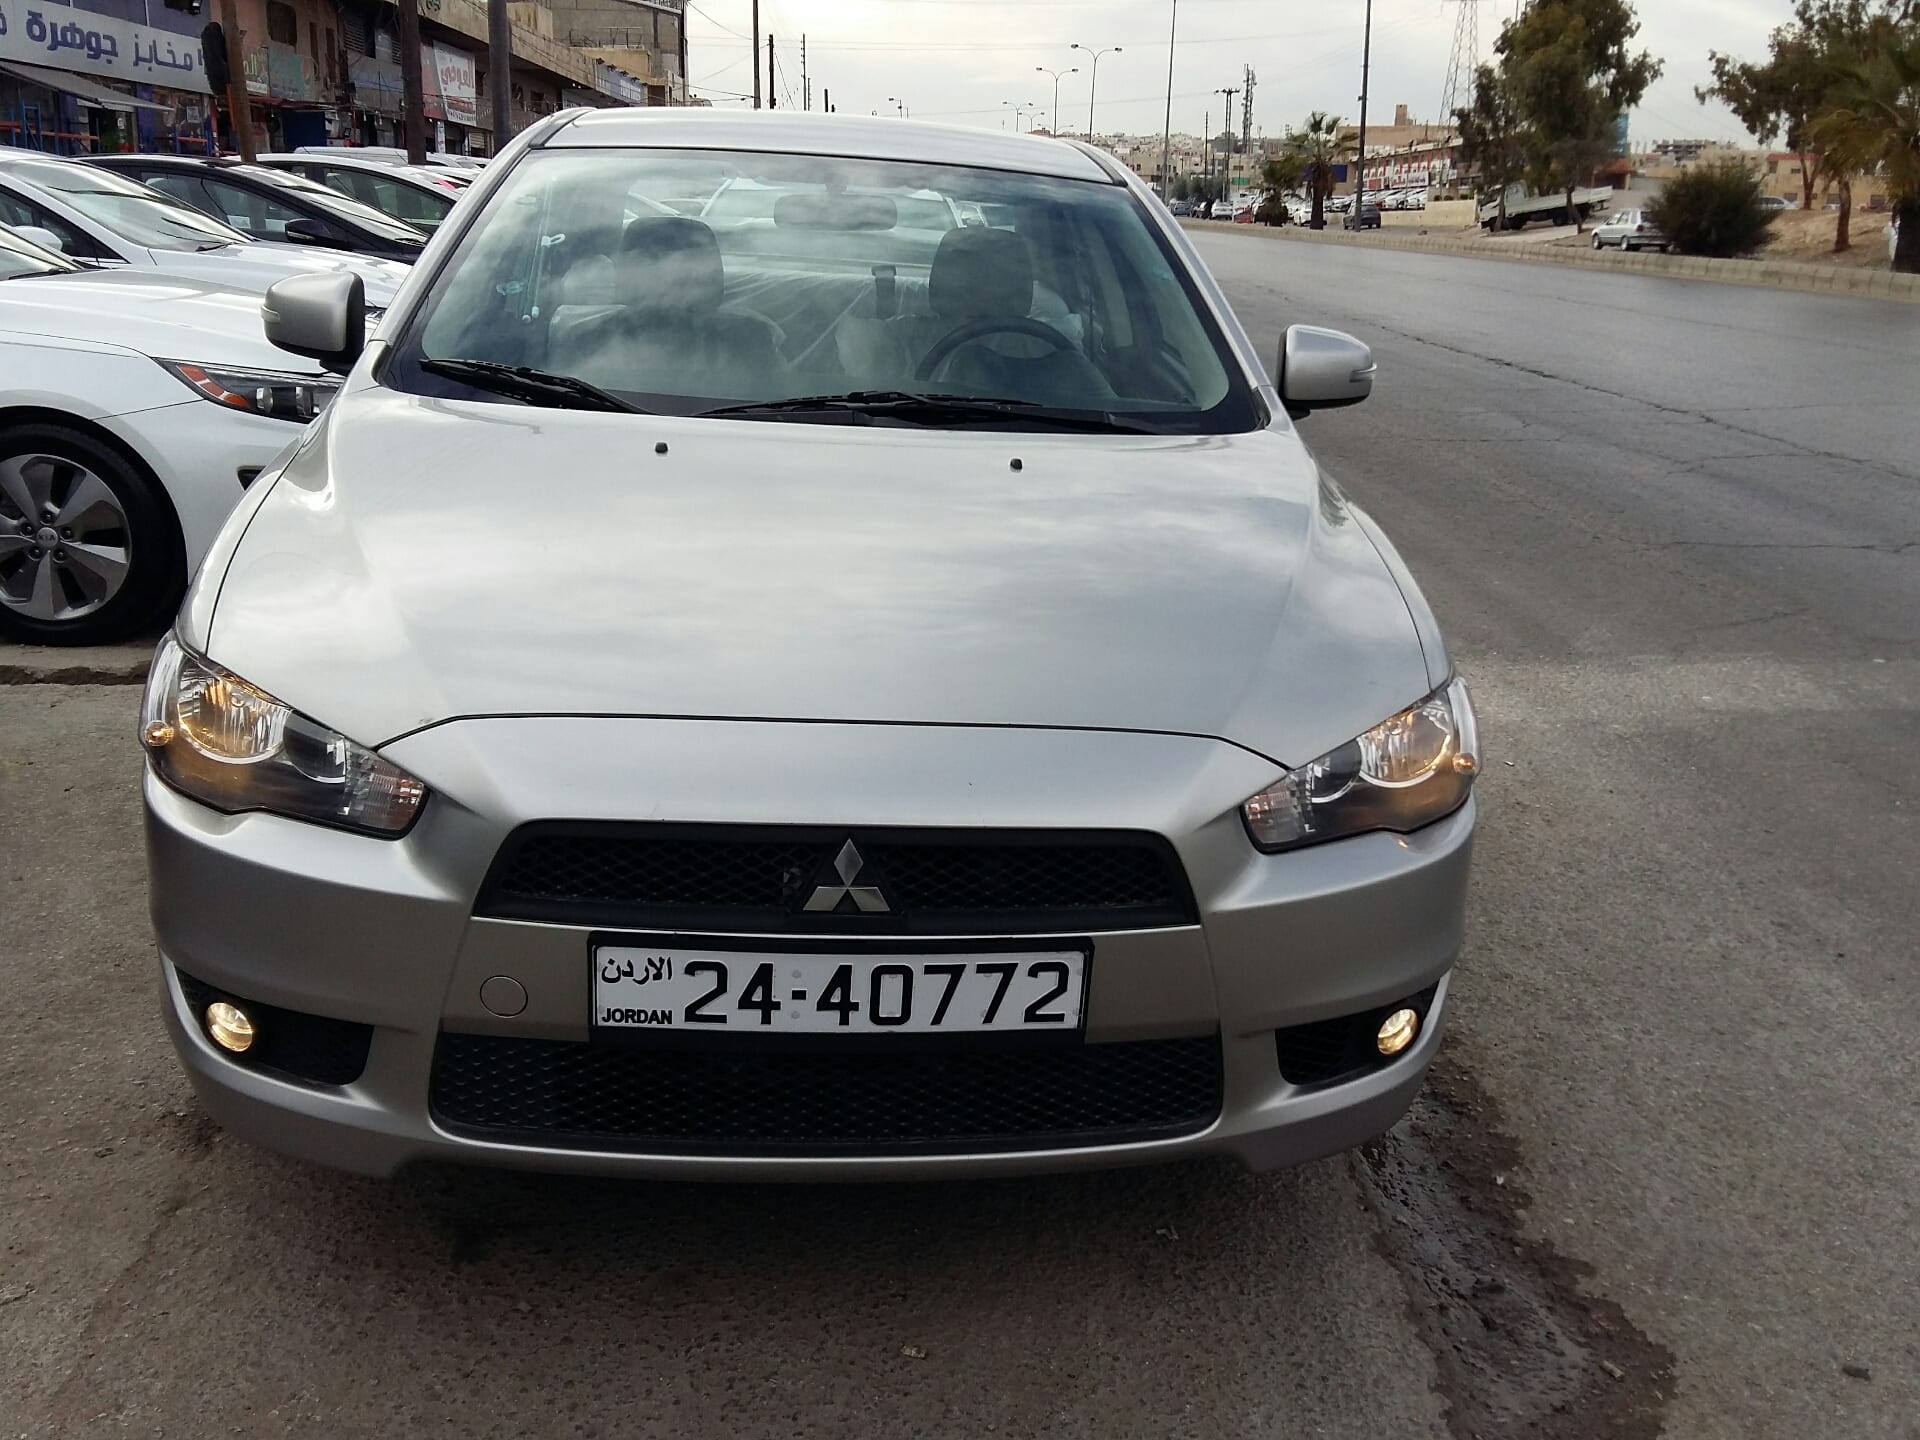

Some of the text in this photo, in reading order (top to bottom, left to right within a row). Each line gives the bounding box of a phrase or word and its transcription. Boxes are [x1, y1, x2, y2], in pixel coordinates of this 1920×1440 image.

[26, 10, 119, 64] جوهرة
[133, 34, 193, 71] مخابز
[602, 956, 673, 985] الاردن
[683, 961, 1071, 1026] 24-40772
[601, 1007, 673, 1025] JORDAN
